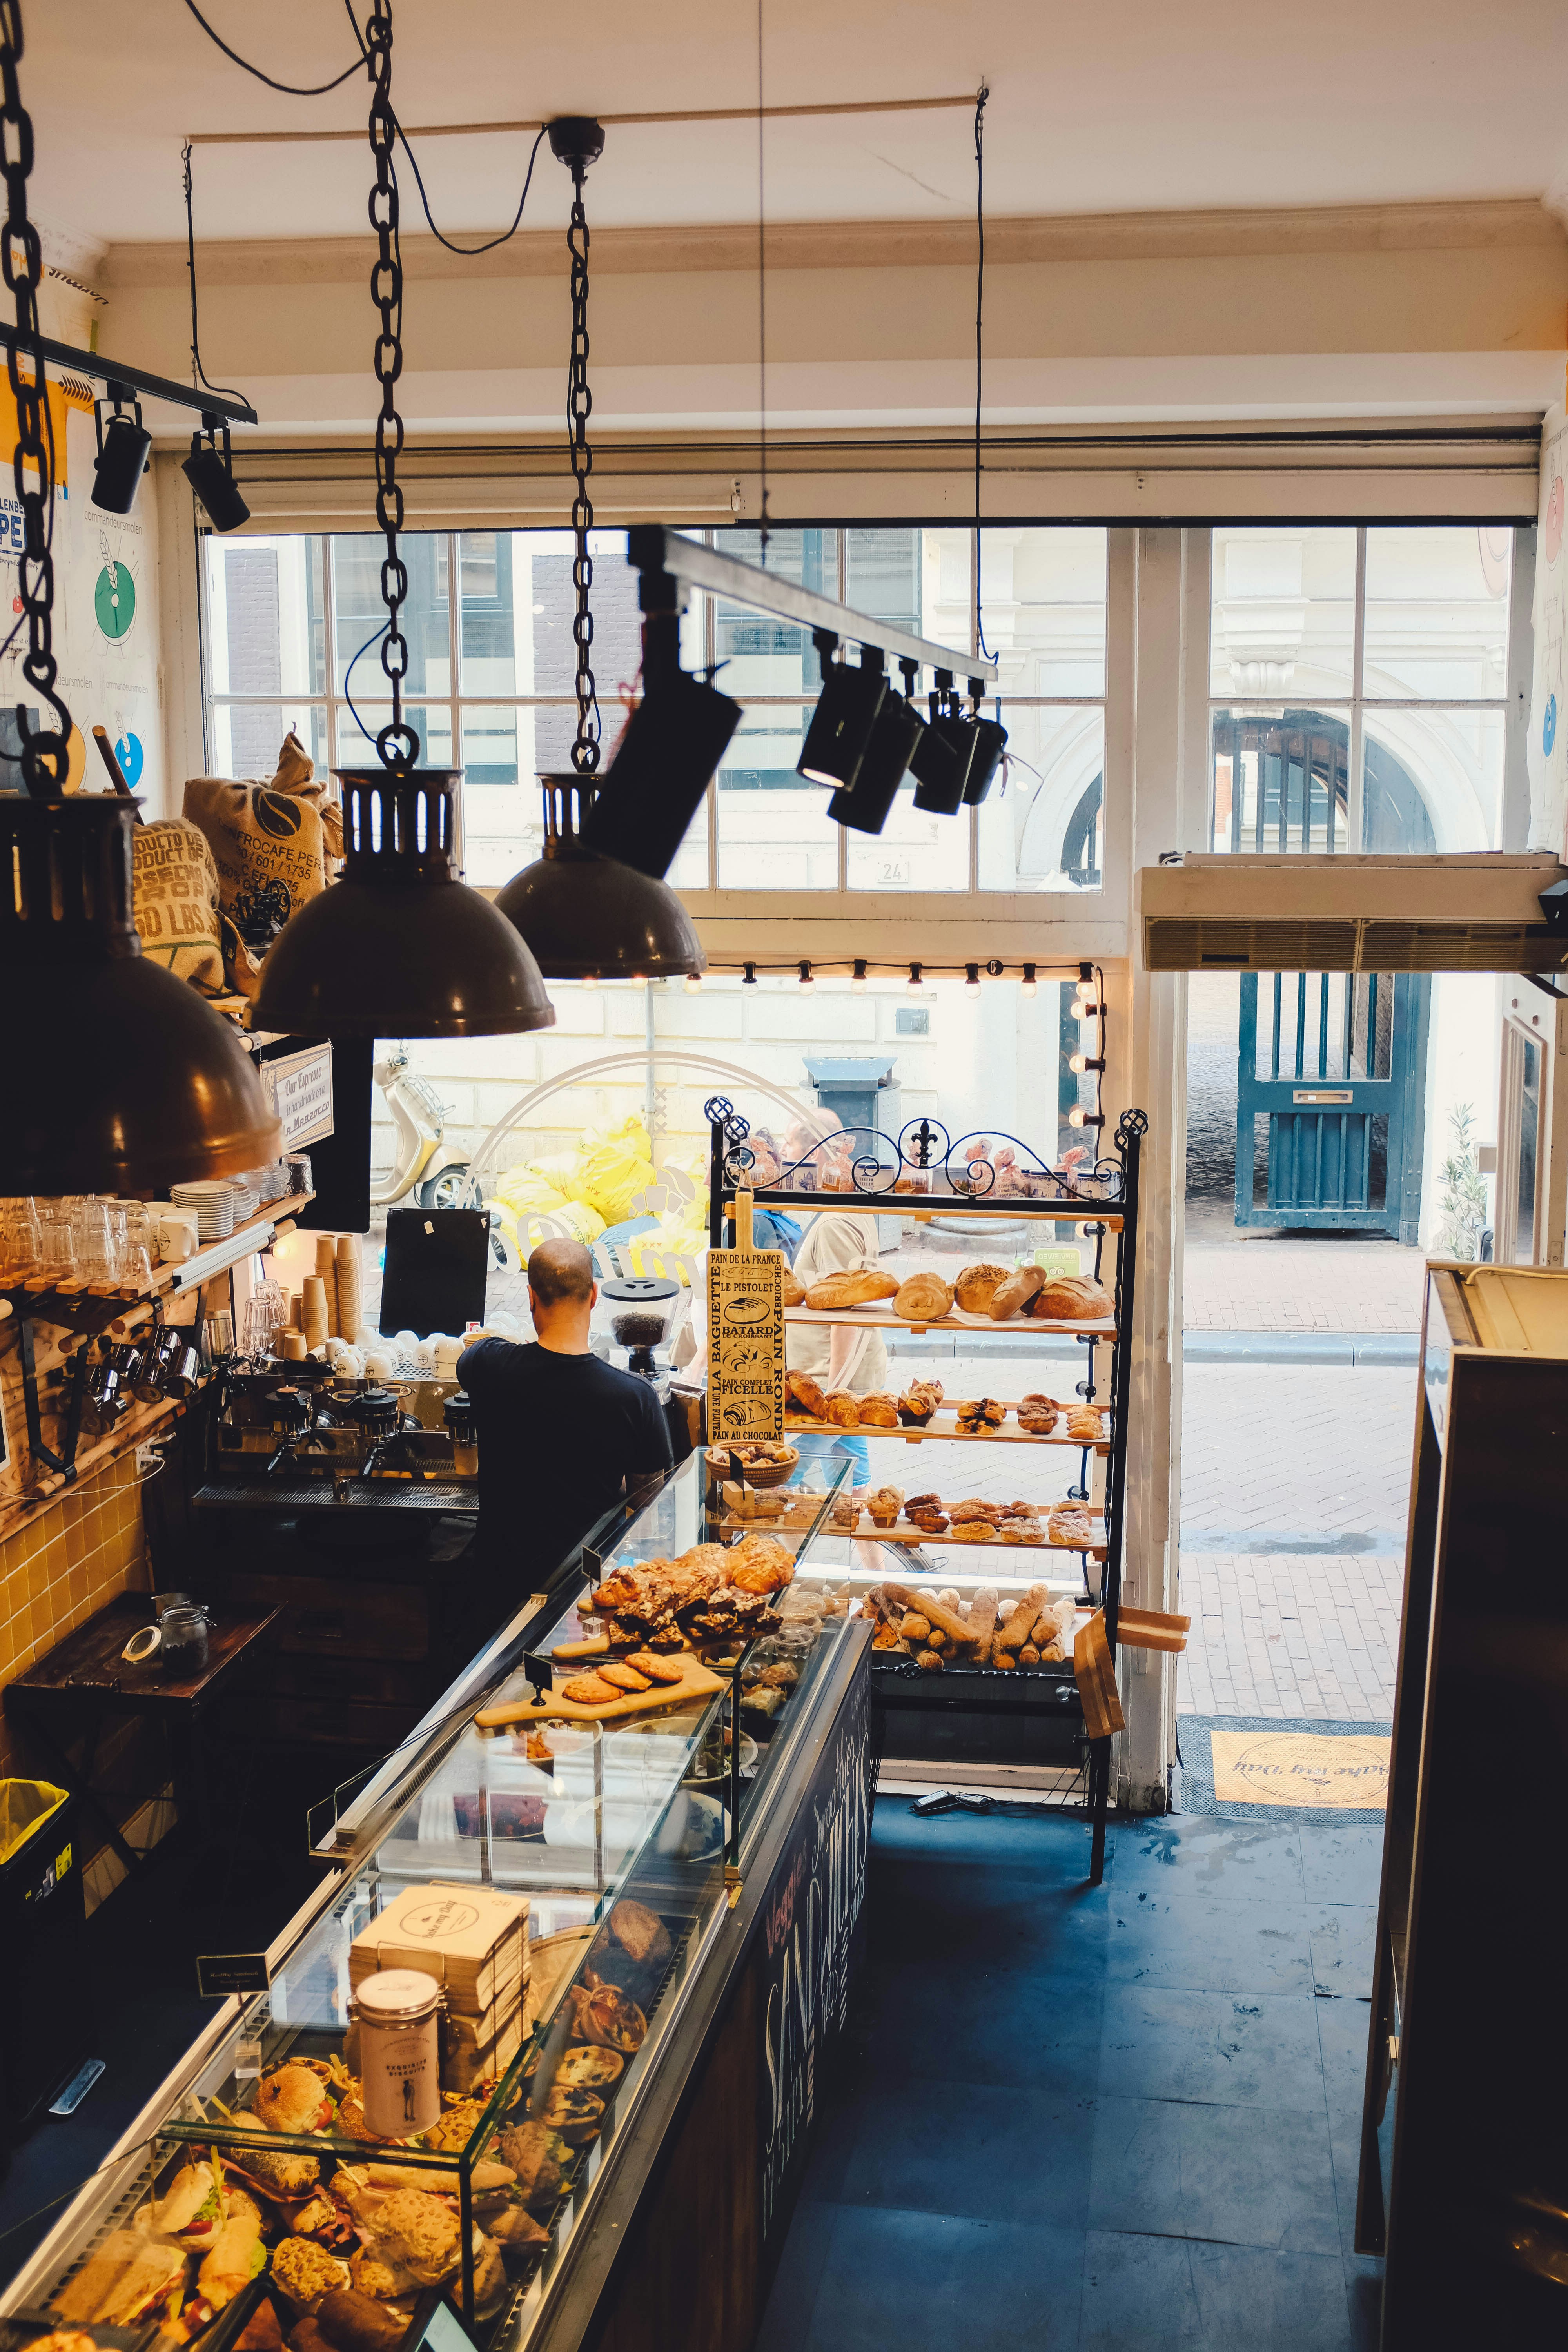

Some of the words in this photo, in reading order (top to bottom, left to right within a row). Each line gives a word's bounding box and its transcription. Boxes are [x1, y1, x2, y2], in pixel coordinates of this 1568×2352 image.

[85, 511, 142, 535] commandeursmolen
[256, 855, 274, 870] 601
[287, 864, 311, 880] 1735
[884, 864, 901, 879] 24
[285, 1080, 297, 1096] Our
[298, 1067, 321, 1091] Espresso
[287, 1105, 290, 1116] is
[291, 1093, 315, 1114] handmade
[316, 1089, 322, 1099] on
[711, 1254, 727, 1264] PAIN
[730, 1254, 739, 1264] DE
[741, 1254, 750, 1264] LA
[752, 1254, 780, 1264] FRANCE
[720, 1283, 731, 1292] LE
[733, 1283, 773, 1292] PISTOLET
[711, 1265, 721, 1363] BAGUETTE
[722, 1326, 773, 1334] BATARD
[774, 1309, 782, 1360] PAIN
[711, 1369, 722, 1392] LA
[722, 1385, 773, 1394] FICELLE
[774, 1368, 782, 1431] ROND
[712, 1431, 728, 1440] PAIN
[731, 1431, 740, 1440] AU
[743, 1431, 782, 1440] CHOCOLAT
[812, 1728, 856, 1873] Smoothies
[439, 1900, 459, 1913] Day
[436, 1914, 450, 1924] my
[422, 1924, 440, 1939] Bake
[766, 1732, 869, 2154] SANDWICHES
